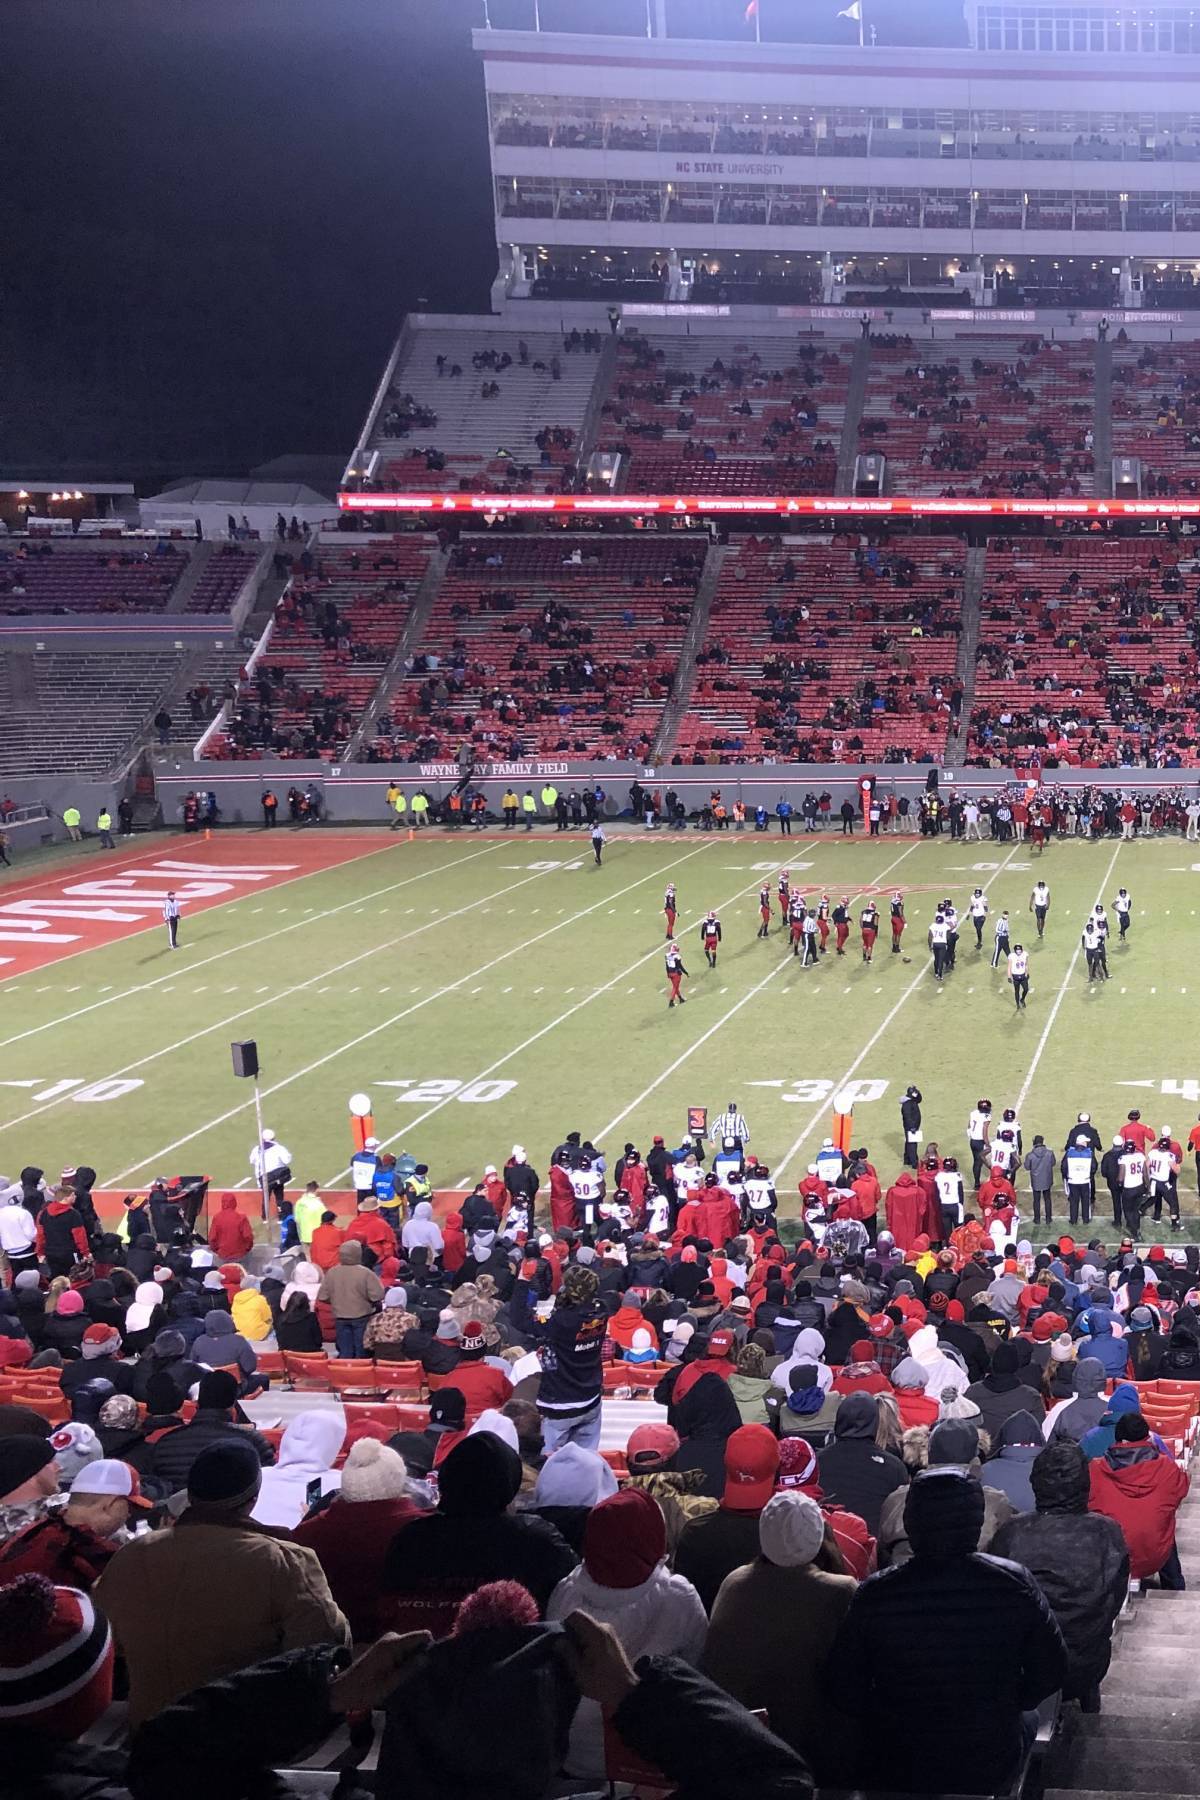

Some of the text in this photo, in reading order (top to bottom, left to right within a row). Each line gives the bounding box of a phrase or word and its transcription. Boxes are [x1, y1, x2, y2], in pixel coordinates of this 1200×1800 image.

[676, 162, 784, 175] NC STATE UNIVERSITY
[331, 768, 341, 776] 17
[420, 762, 569, 776] WAYNE AY FAMILY FIELD
[644, 769, 655, 778] 18
[943, 772, 954, 781] 19
[31, 1079, 145, 1102] 10
[395, 1079, 519, 1102] 20
[780, 1079, 890, 1102] 30
[690, 1109, 705, 1128] 3
[994, 1150, 1005, 1163] 18
[1130, 1163, 1143, 1175] 85
[1150, 1161, 1162, 1173] 41
[575, 1183, 590, 1195] 50
[943, 1181, 951, 1195] 2
[749, 1189, 764, 1202] 27
[465, 1336, 483, 1348] NC
[574, 1341, 596, 1352] Mobil
[397, 1600, 464, 1608] WOLFP
